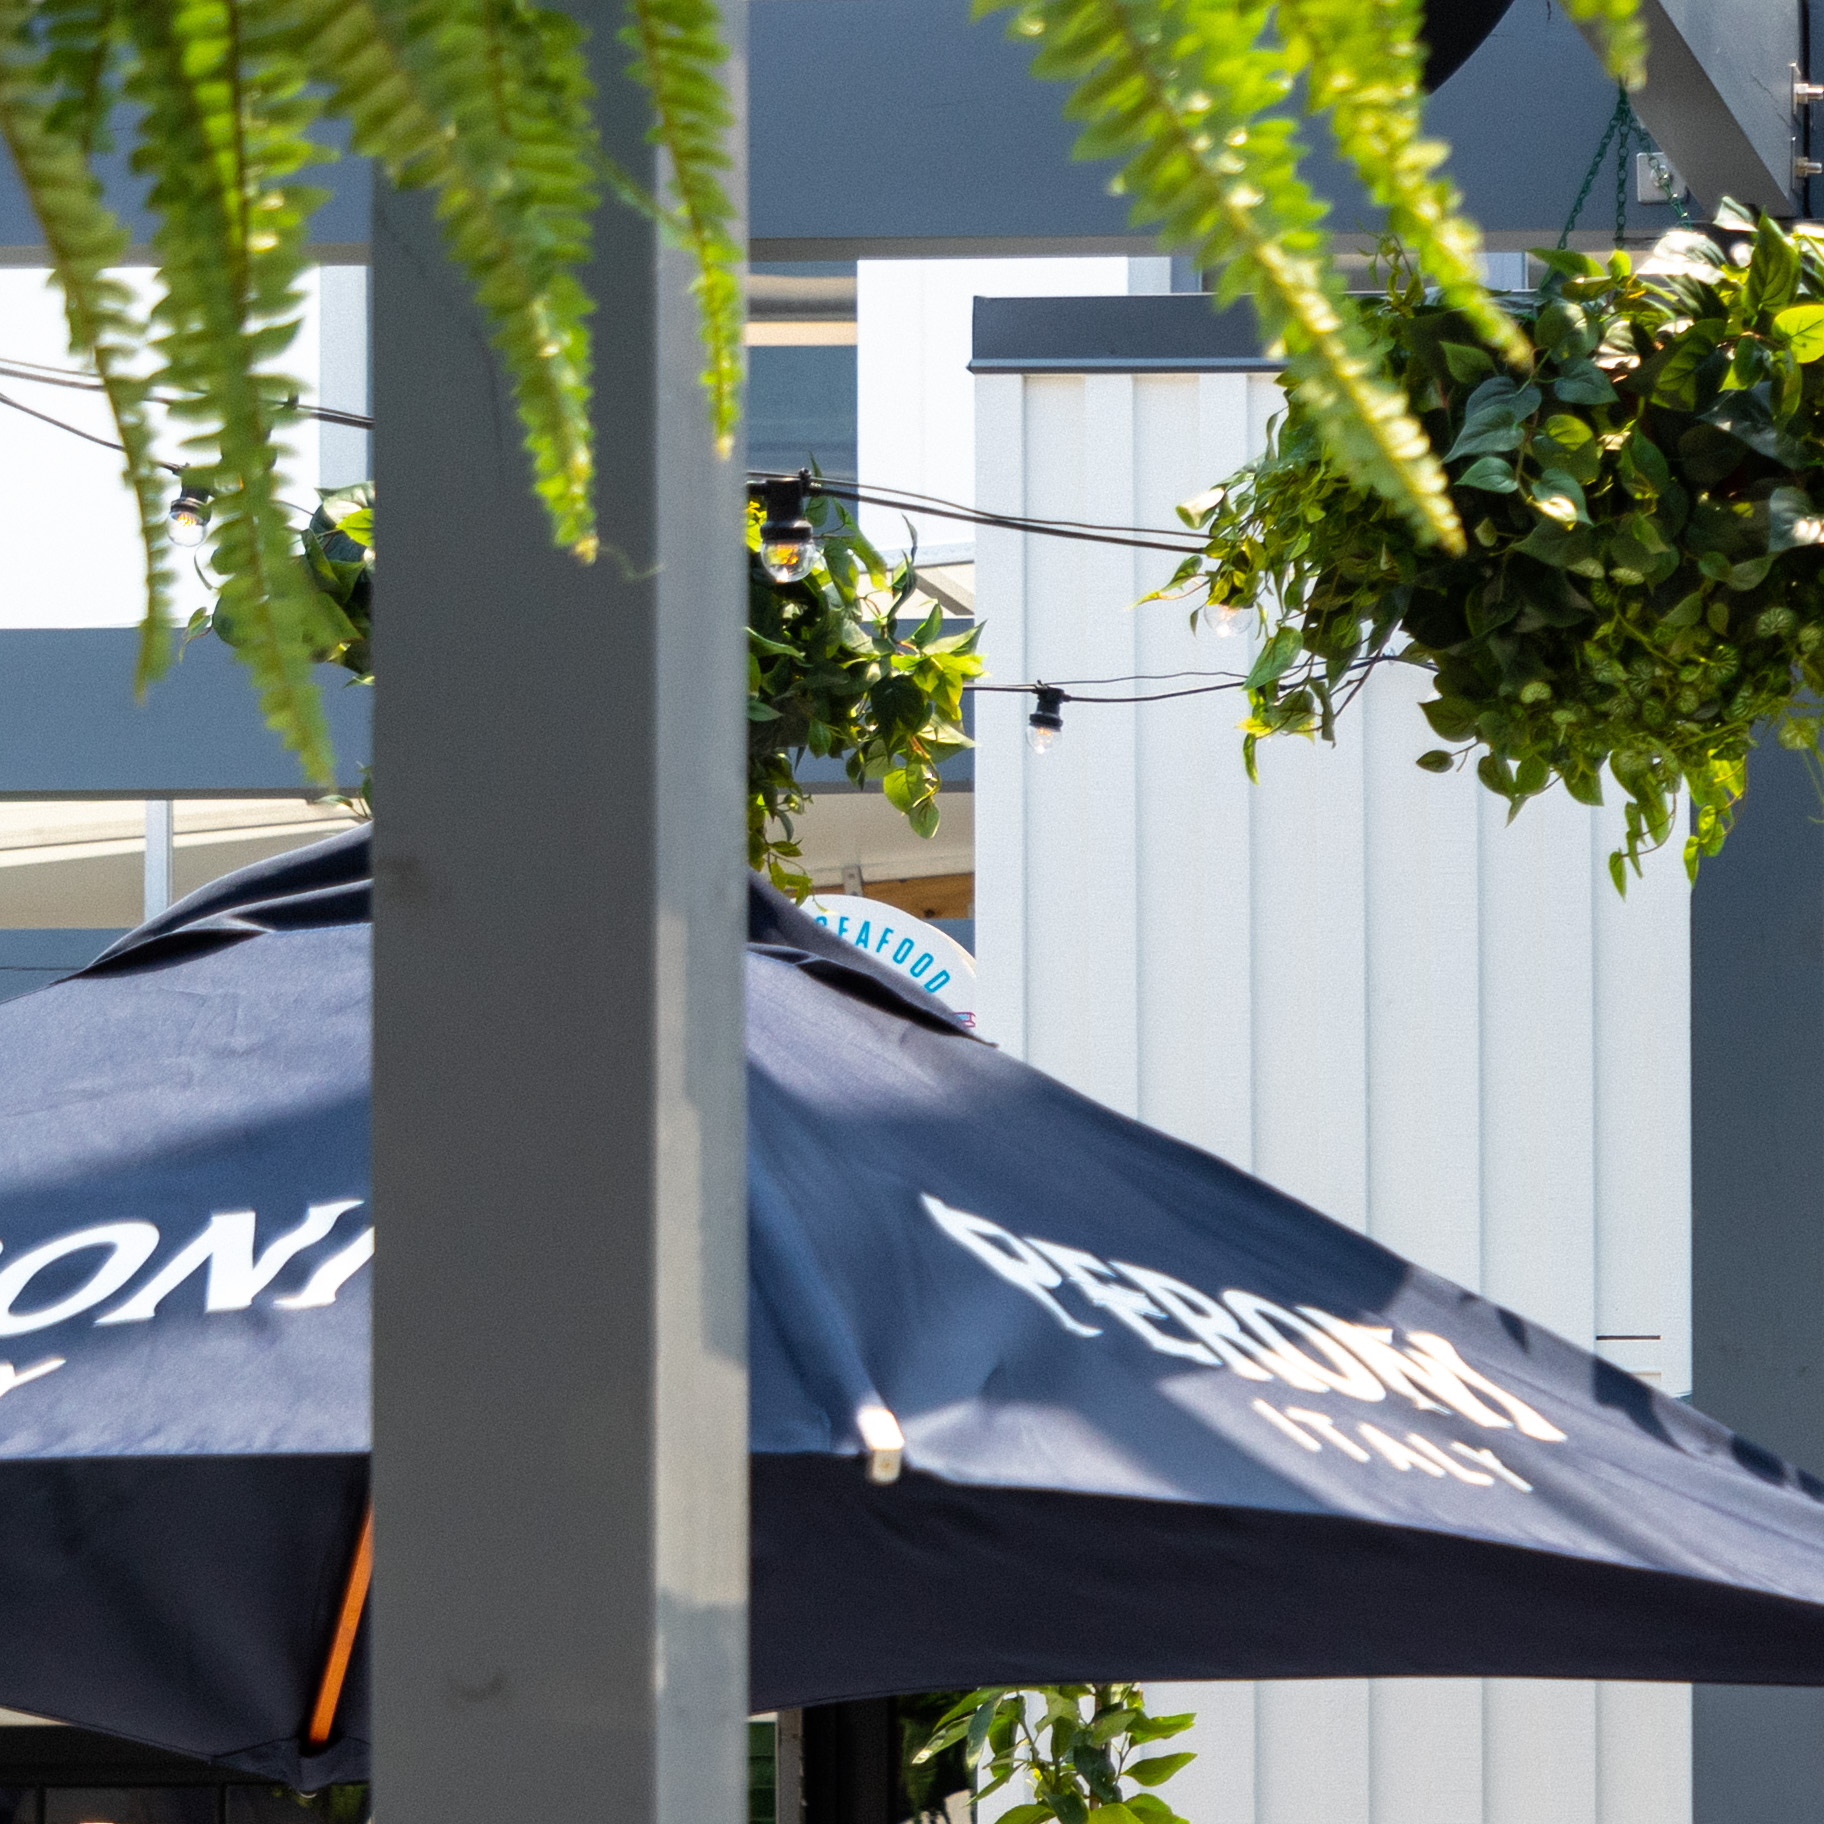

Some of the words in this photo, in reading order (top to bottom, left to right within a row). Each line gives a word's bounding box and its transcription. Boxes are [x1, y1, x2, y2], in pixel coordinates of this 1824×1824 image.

[0, 1197, 375, 1337] ONI
[921, 1192, 1568, 1442] PERONI
[1252, 1398, 1532, 1494] ITALY
